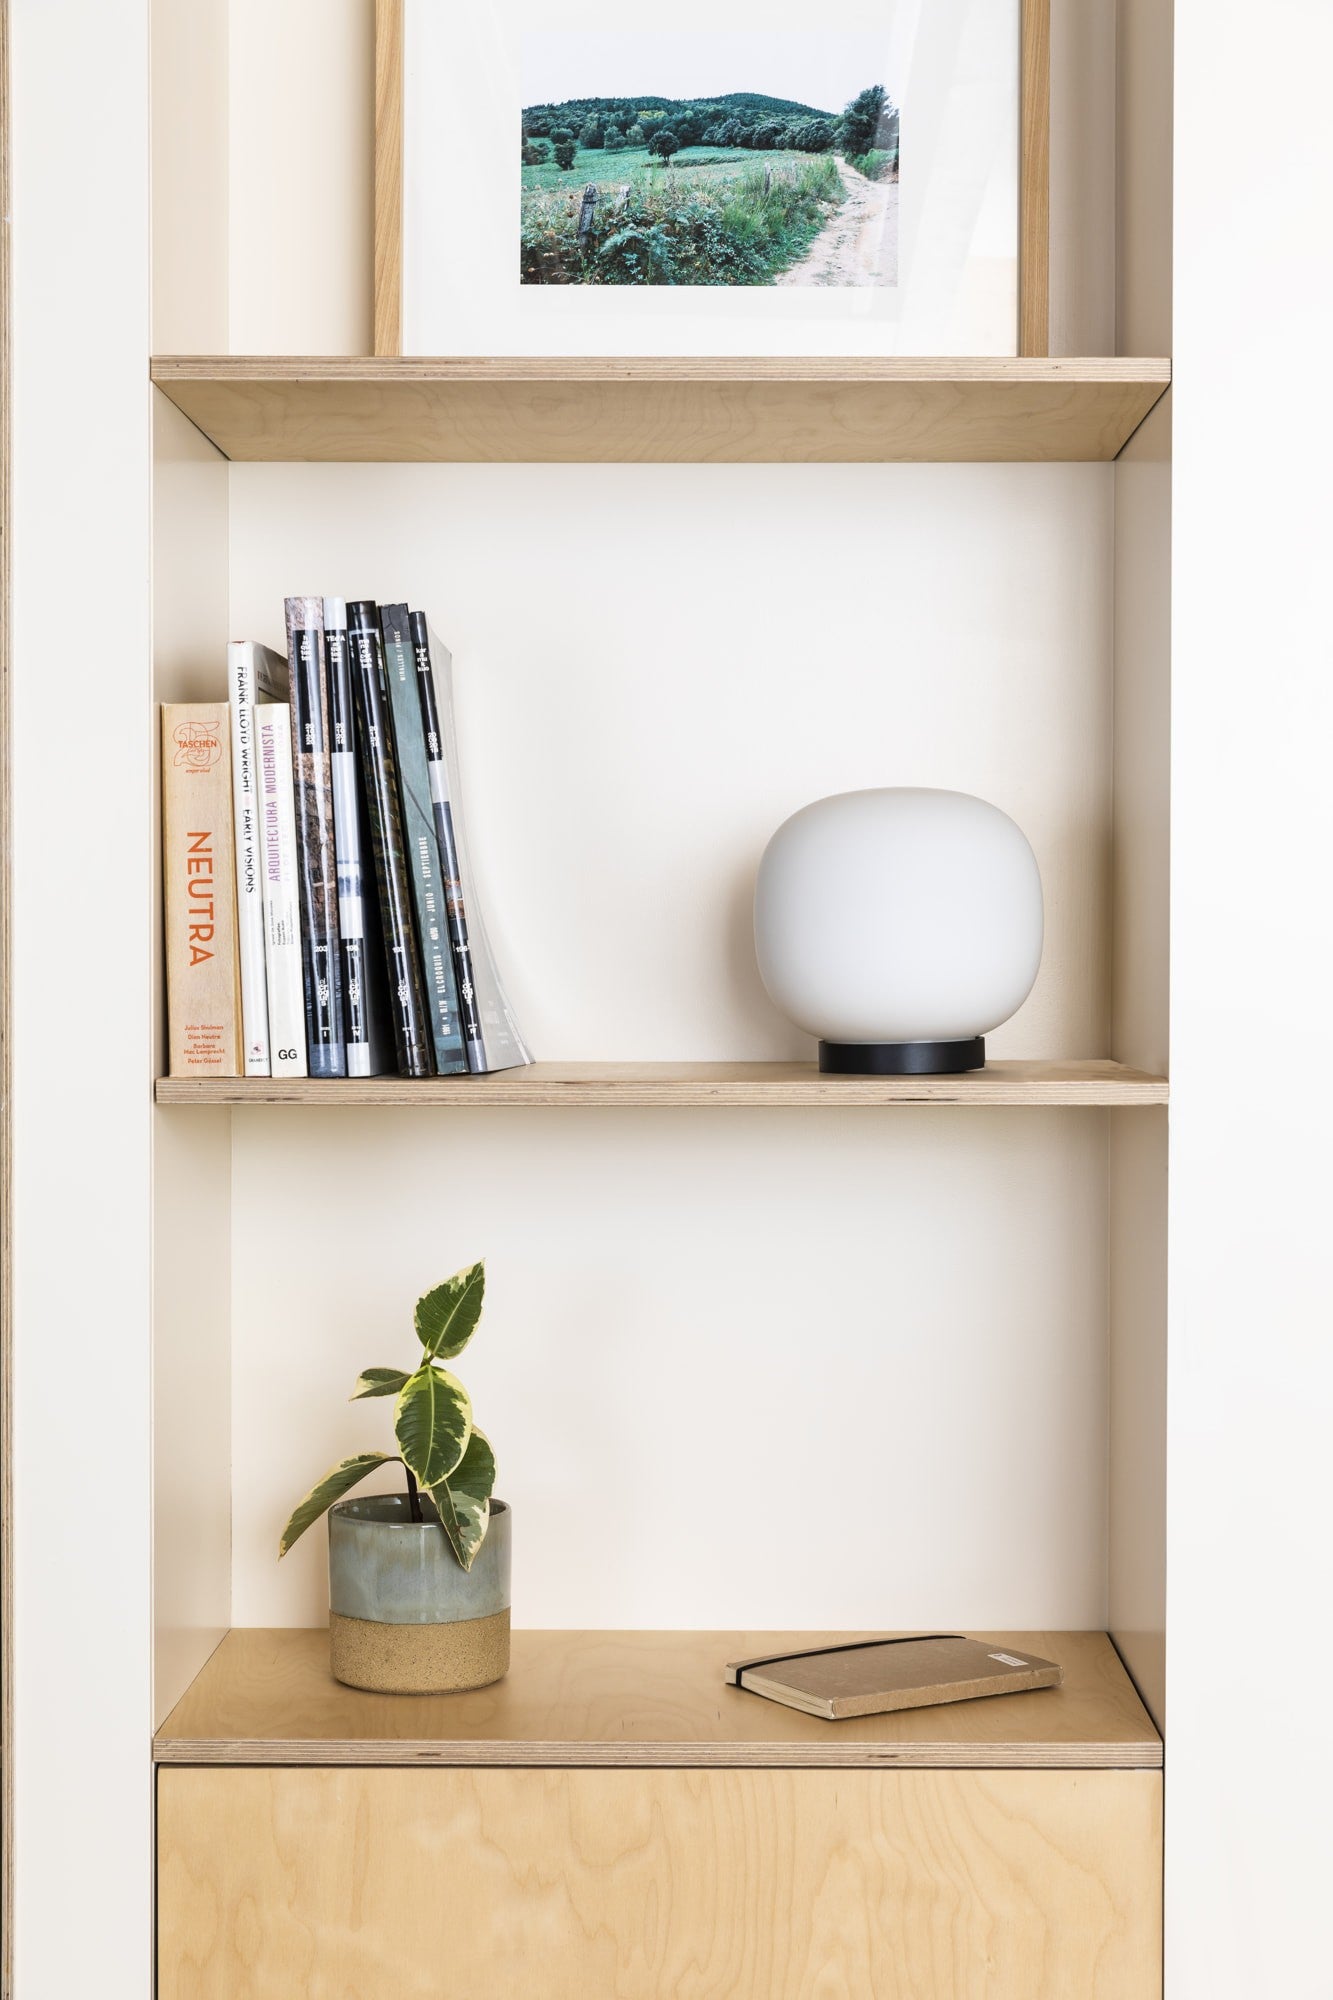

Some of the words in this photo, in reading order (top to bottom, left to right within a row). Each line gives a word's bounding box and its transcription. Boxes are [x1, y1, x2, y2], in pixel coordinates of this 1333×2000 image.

[237, 666, 248, 704] FRANK
[178, 740, 217, 748] TASCHEN
[239, 709, 250, 744] LLOYD
[241, 749, 252, 793] WRIGHT
[262, 724, 277, 794] MODERNISTA
[242, 809, 253, 841] EARLY
[266, 801, 281, 881] ARQUITECTURA
[244, 847, 256, 893] VISIONS
[418, 837, 432, 878] SEPTIEMBRE
[187, 832, 215, 966] NEUTRA
[425, 892, 436, 912] JUNIO
[433, 955, 445, 984] CROQUIS
[278, 1049, 297, 1060] GG
